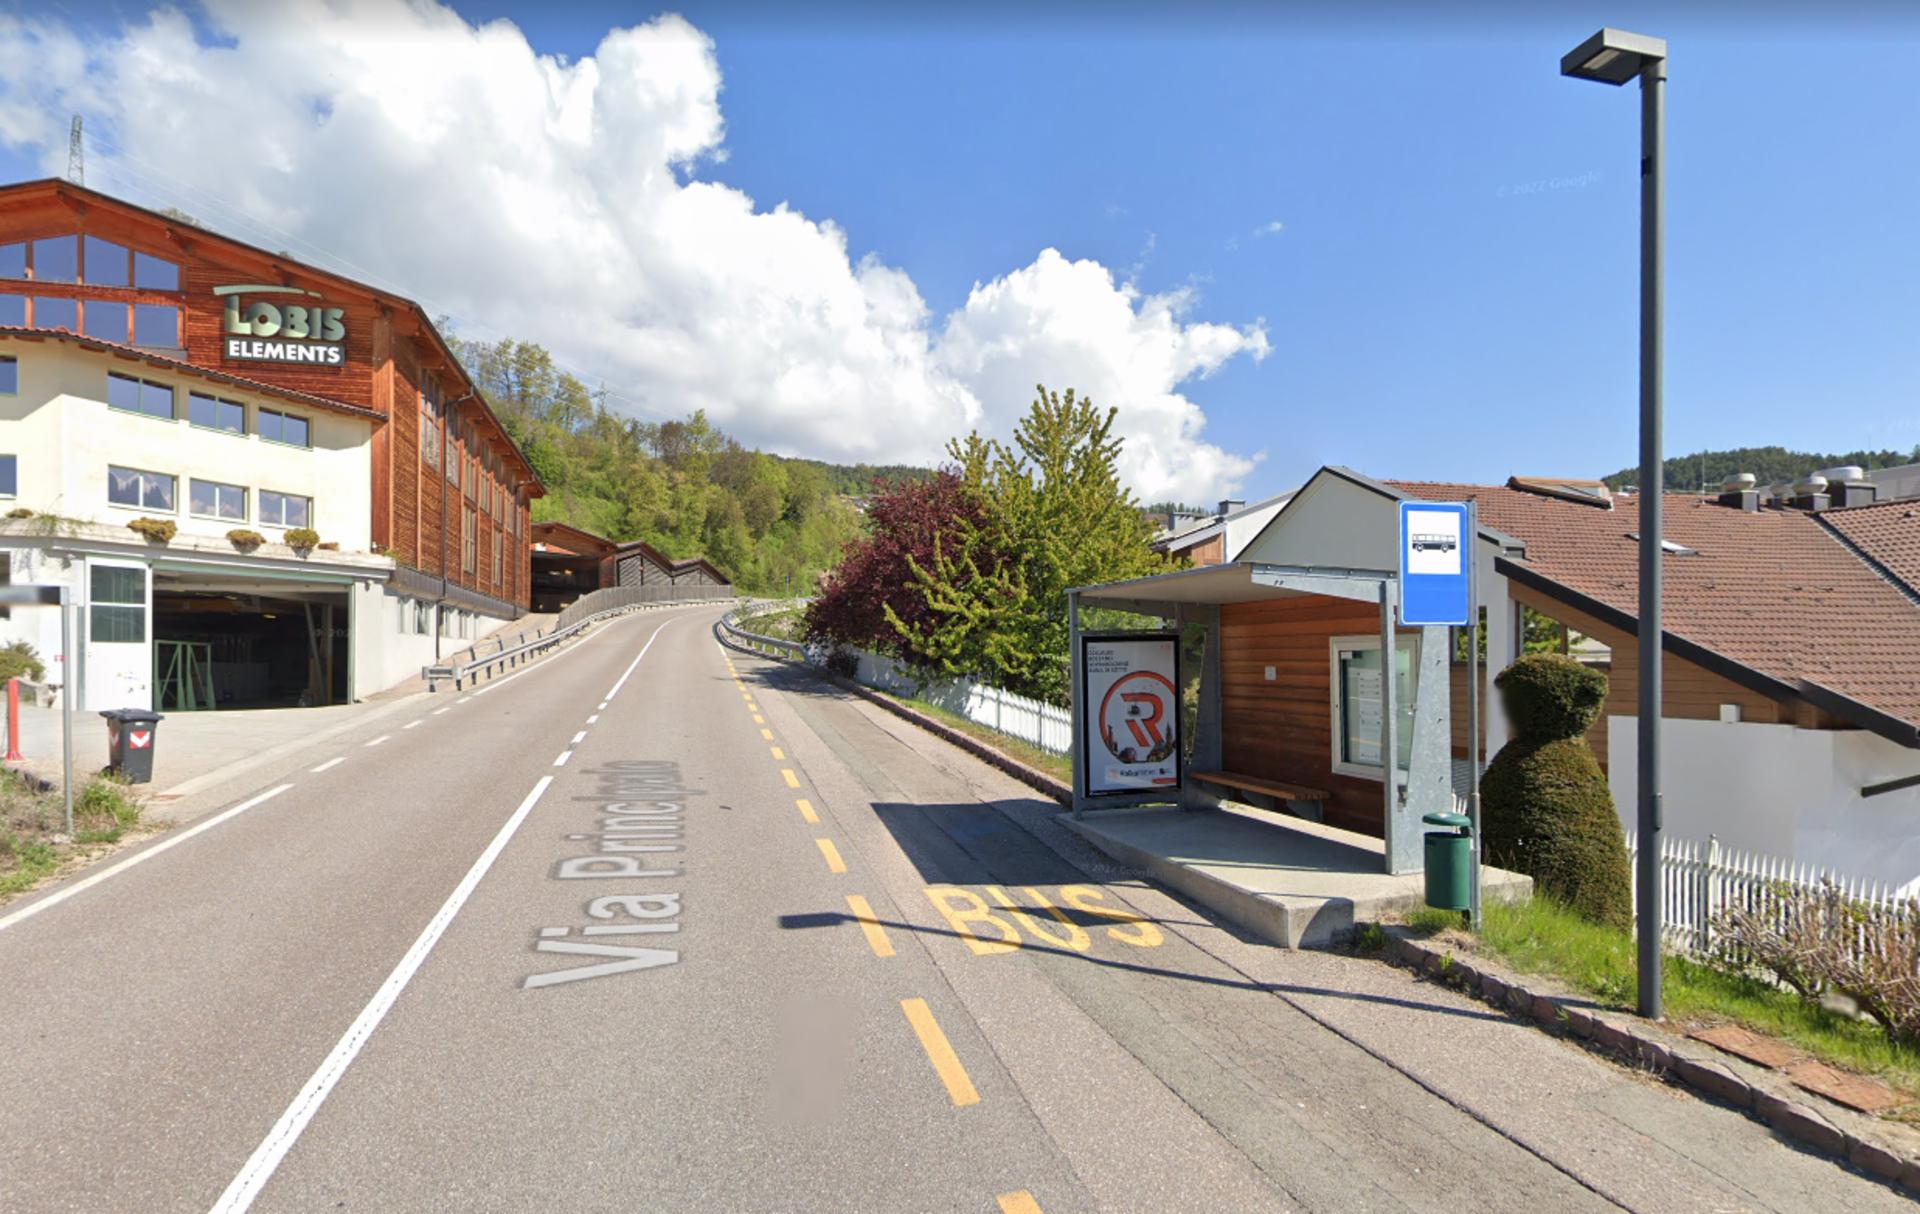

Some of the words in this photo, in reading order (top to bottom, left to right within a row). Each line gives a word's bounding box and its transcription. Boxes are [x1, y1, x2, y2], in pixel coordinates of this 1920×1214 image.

[224, 294, 346, 342] LOBIS
[228, 339, 341, 363] ELEMENTS
[1120, 692, 1165, 748] R
[923, 884, 1165, 956] BUS
